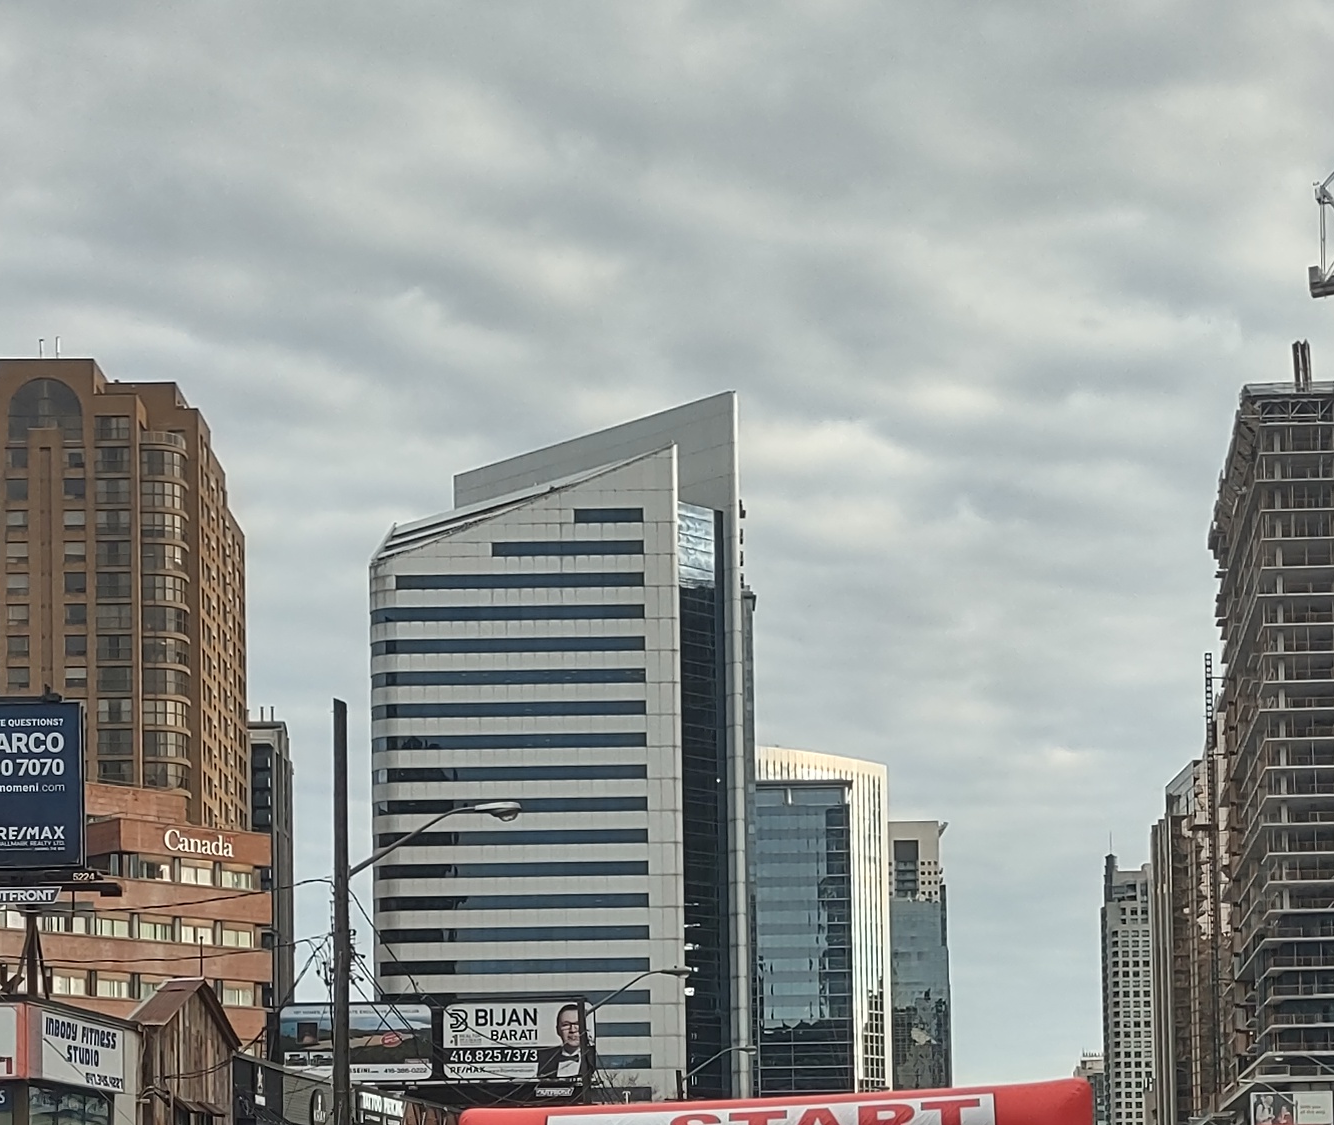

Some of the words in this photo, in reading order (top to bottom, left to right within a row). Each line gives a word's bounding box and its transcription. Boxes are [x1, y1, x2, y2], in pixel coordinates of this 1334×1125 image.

[8, 718, 64, 727] QUESTIONS?
[15, 758, 65, 776] 7070
[164, 829, 235, 858] Canada
[72, 873, 95, 881] 5224
[475, 1008, 538, 1026] BIJAN
[45, 1016, 78, 1041] INBODY
[81, 1026, 117, 1050] FITNESS
[491, 1029, 538, 1041] BARATI
[67, 1044, 100, 1067] STUDIO
[450, 1049, 538, 1062] 416.825.7373
